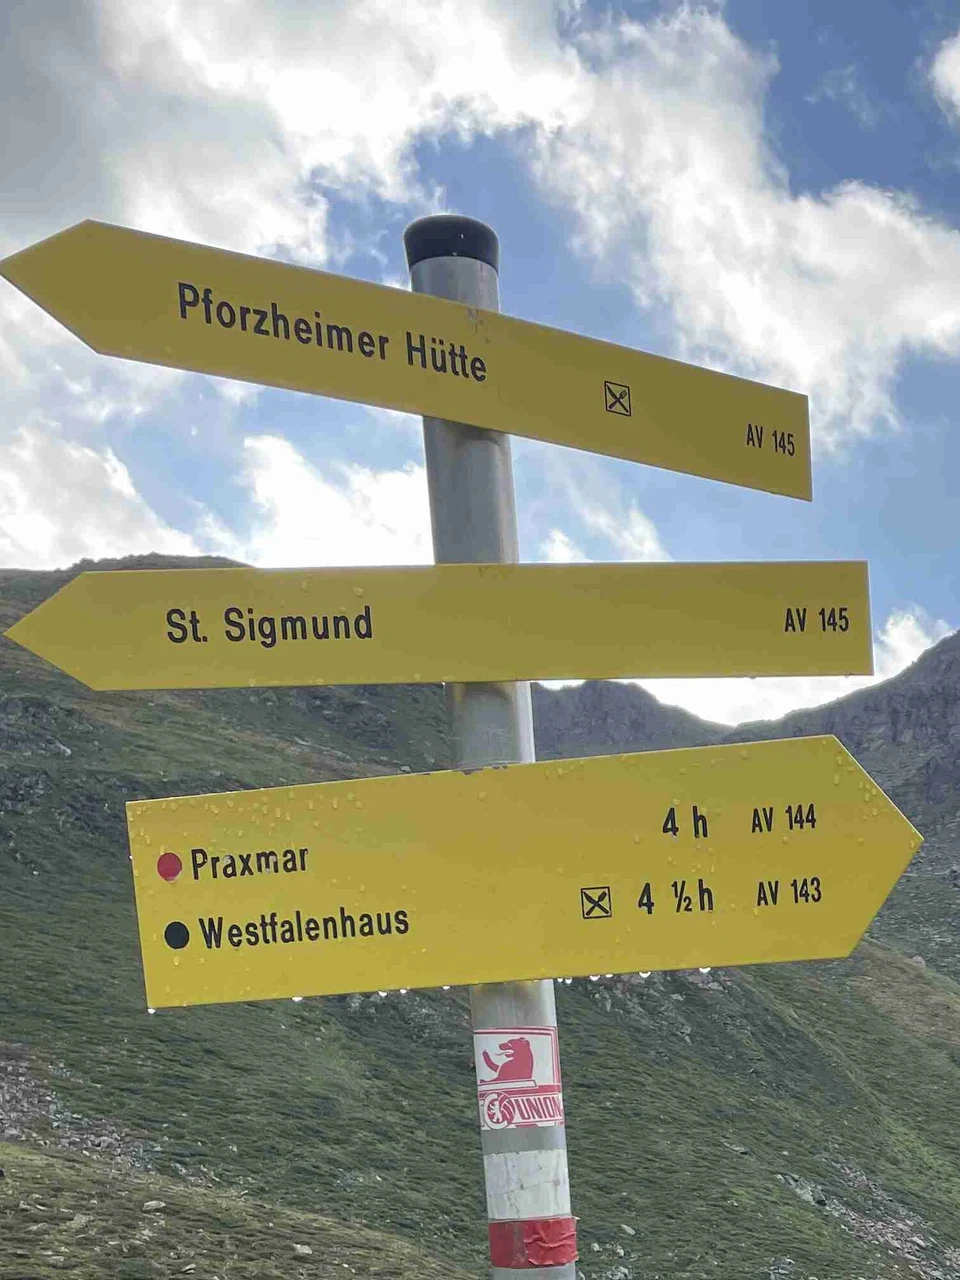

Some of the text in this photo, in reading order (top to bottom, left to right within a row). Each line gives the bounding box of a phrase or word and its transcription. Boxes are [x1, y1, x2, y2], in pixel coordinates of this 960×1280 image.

[178, 282, 487, 381] Pforzheimer Hütte
[746, 423, 795, 456] AV 145
[167, 605, 373, 648] St. Sigmund
[784, 607, 850, 633] AV 145
[662, 806, 708, 838] 4 h
[752, 804, 817, 833] AV 144
[191, 848, 308, 880] Praxmar
[638, 883, 654, 914] 4
[757, 877, 822, 906] AV 143
[198, 907, 409, 949] Westfalenhaus
